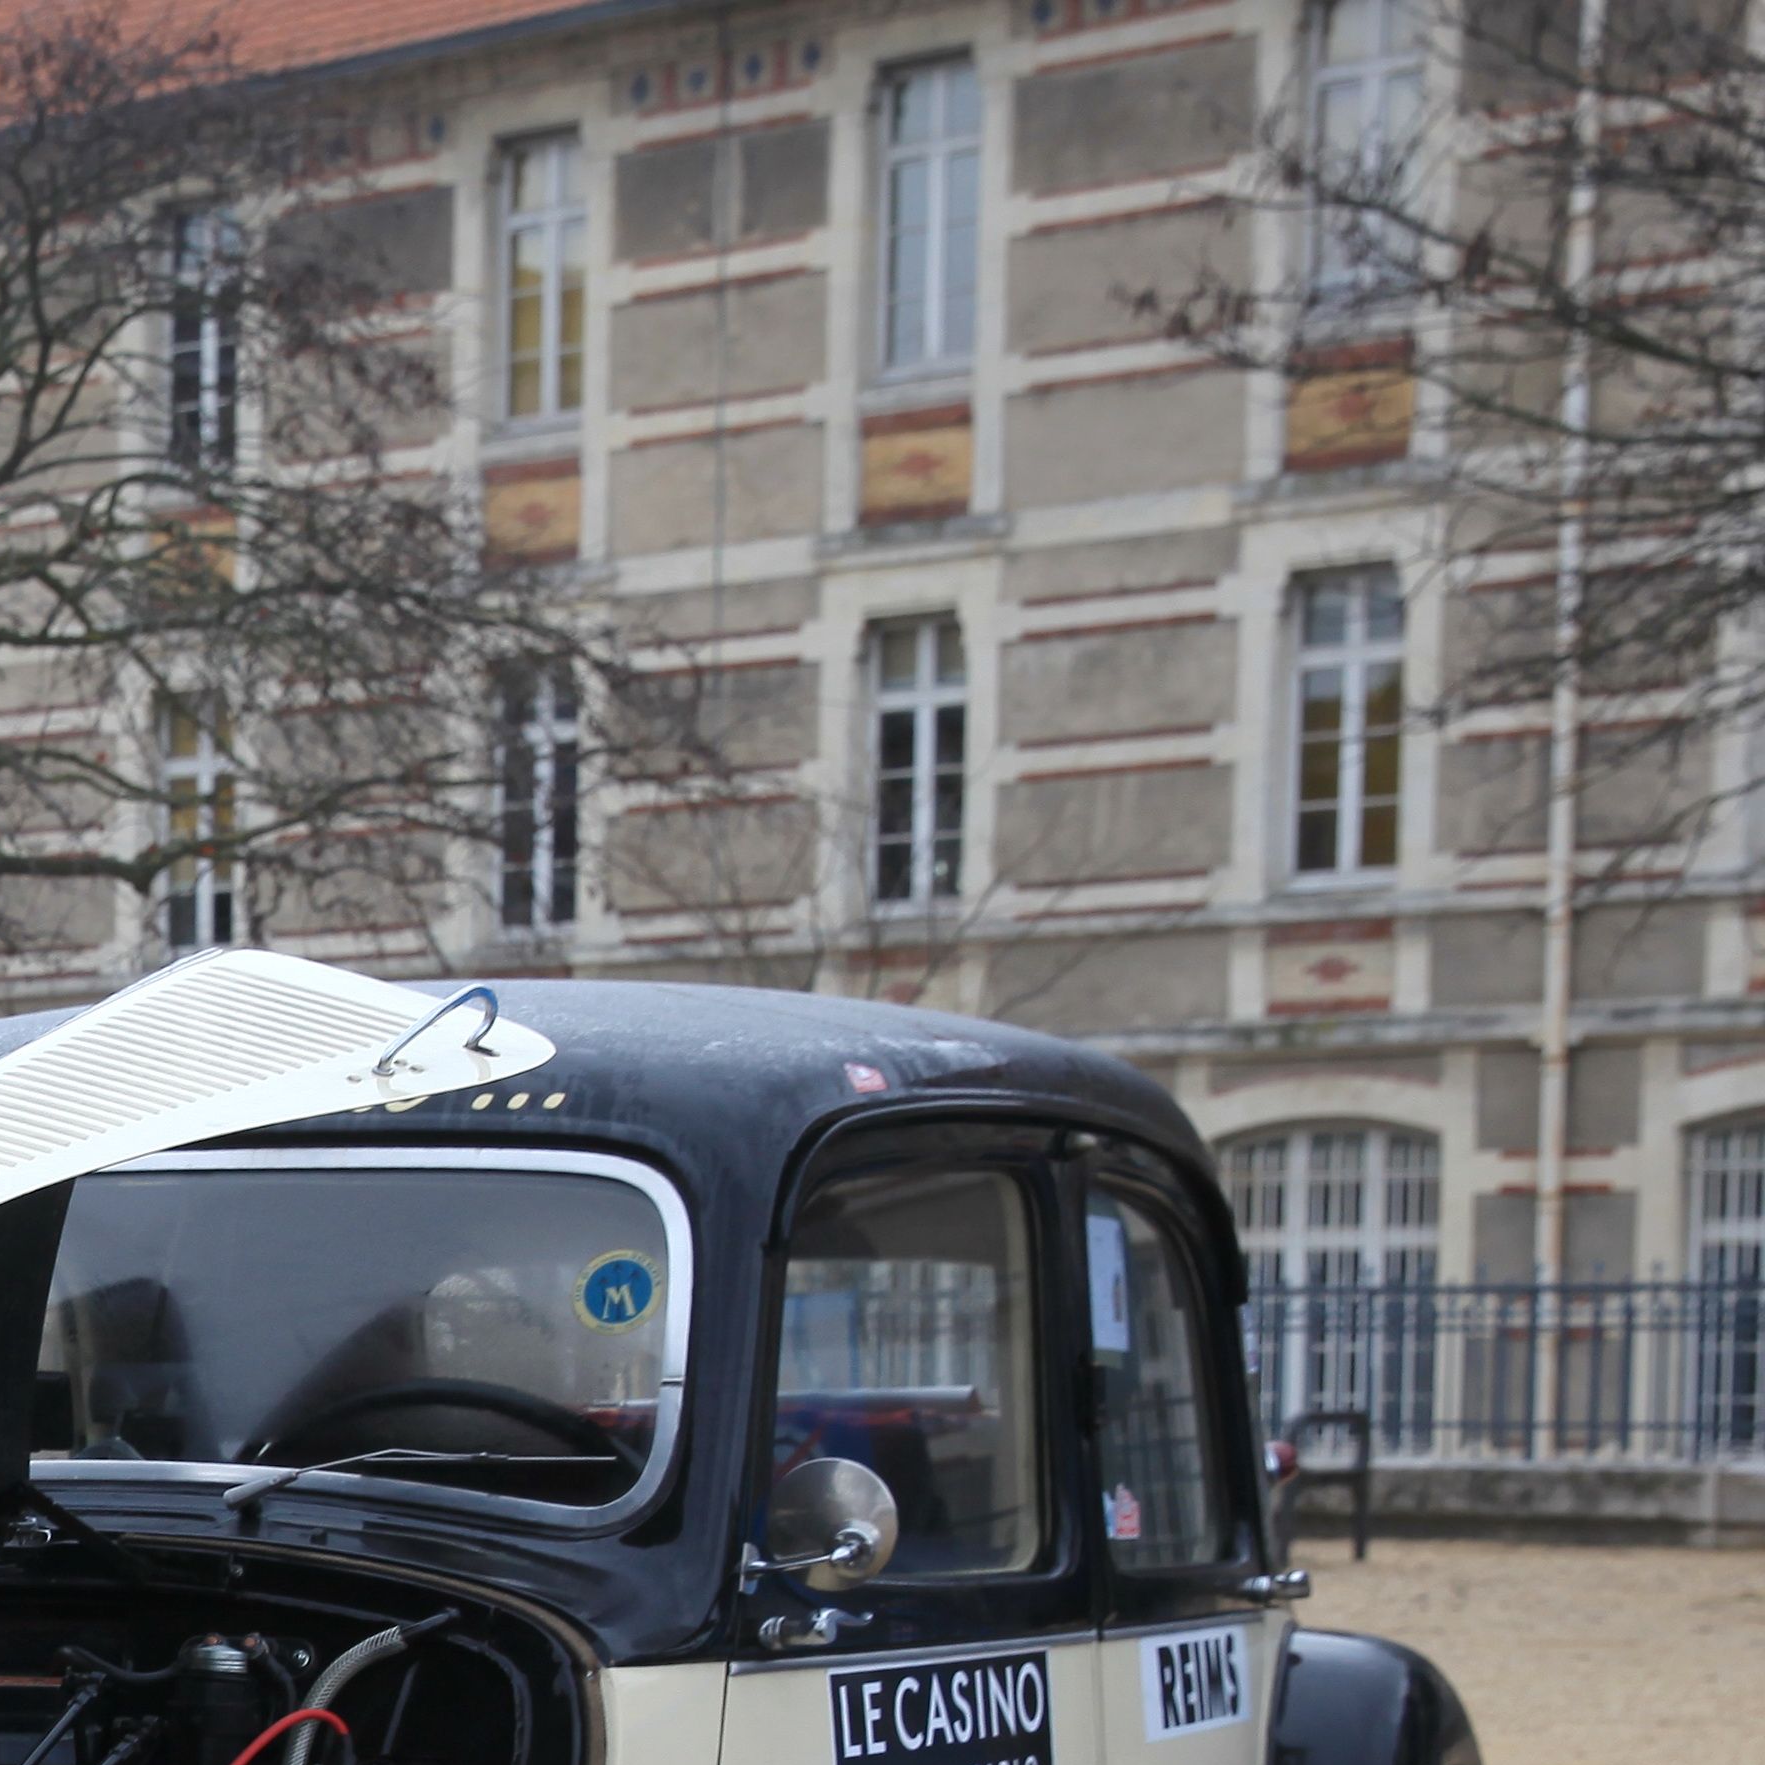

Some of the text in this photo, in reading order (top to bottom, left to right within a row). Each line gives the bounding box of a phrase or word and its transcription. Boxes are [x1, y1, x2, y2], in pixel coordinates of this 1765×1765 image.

[602, 1282, 638, 1320] M
[838, 1661, 1046, 1759] LE CASINO
[1156, 1633, 1241, 1730] REIMS
